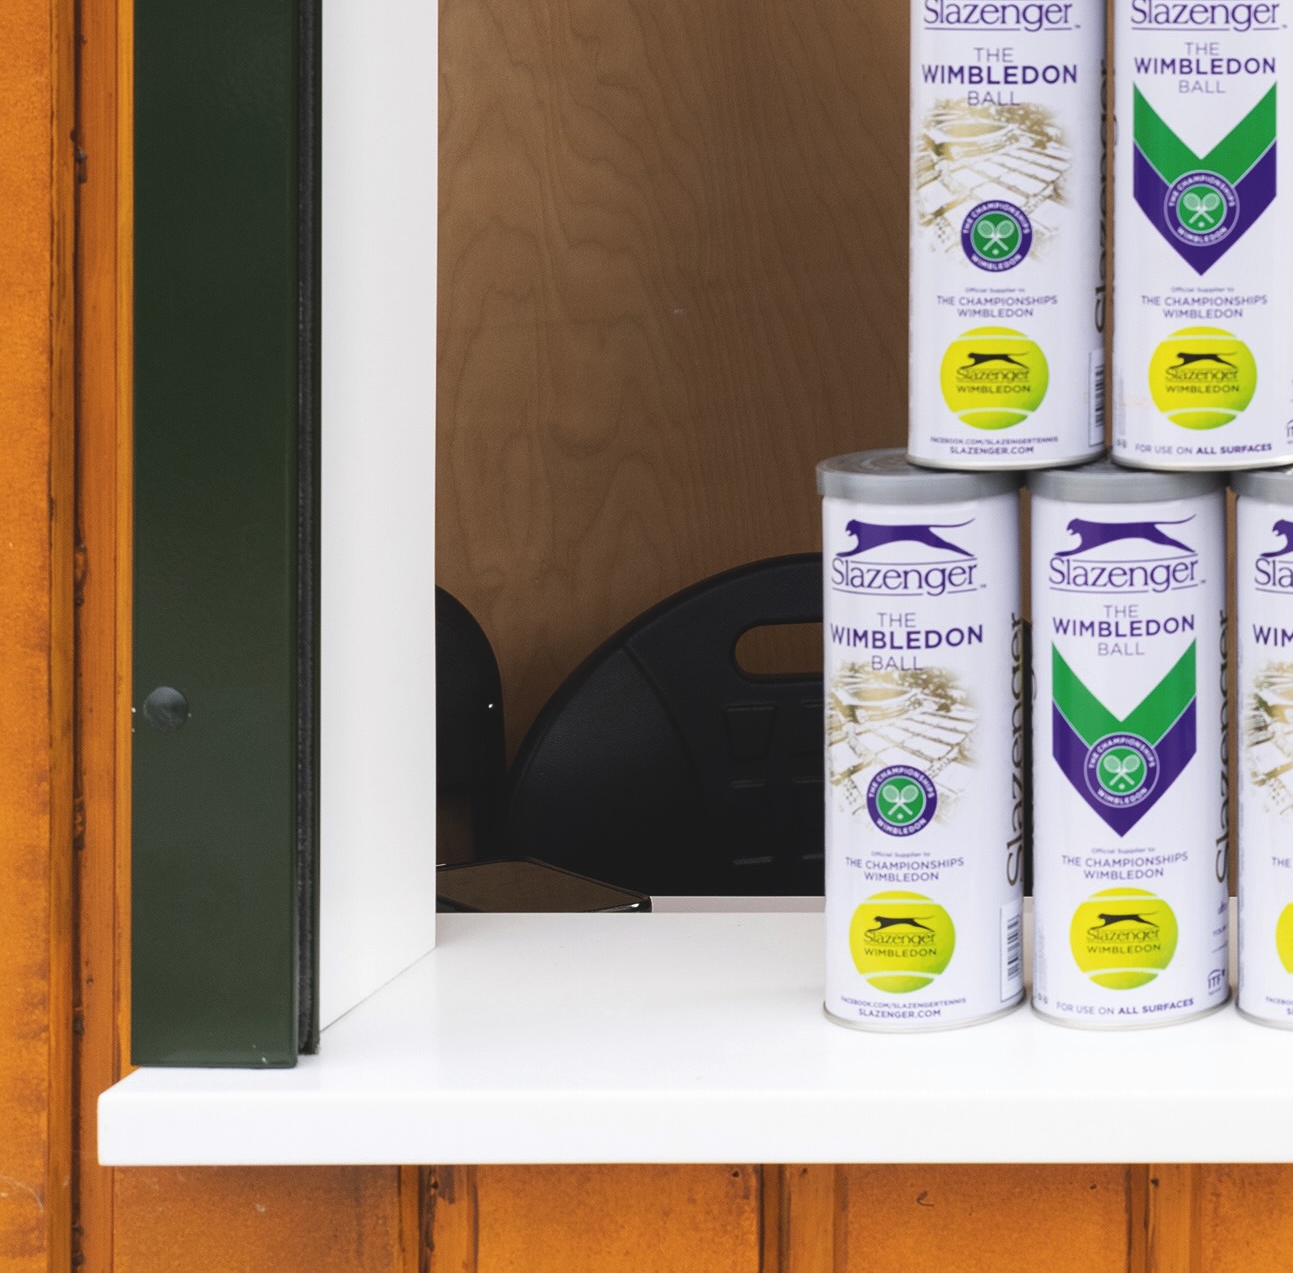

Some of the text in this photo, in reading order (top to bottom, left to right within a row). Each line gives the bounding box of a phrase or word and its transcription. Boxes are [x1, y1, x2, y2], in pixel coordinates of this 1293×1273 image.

[974, 47, 1013, 62] THE
[1185, 42, 1219, 55] THE
[1135, 58, 1275, 73] WIMBLEDON
[922, 64, 1077, 84] WIMBLEDON
[1178, 80, 1226, 93] BALL
[967, 91, 1020, 106] BALL
[937, 295, 1058, 306] THE CHAMPIONSHIPS
[1141, 295, 1267, 306] THE CHAMPIONSHIPS
[957, 308, 1033, 318] WIMBLEDON
[1163, 308, 1243, 319] WIMBLEDON
[950, 446, 1034, 454] SLAZENGER.COM
[1220, 443, 1272, 454] SURFACES
[832, 558, 977, 596] Slazenger
[1050, 557, 1198, 593] Slazenger
[1104, 605, 1138, 618] THE
[877, 613, 916, 628] THE
[1052, 614, 1194, 637] WIMBLEDON
[830, 625, 983, 650] WIMBLEDON
[1098, 642, 1144, 656] BALL
[872, 656, 924, 671] BALL
[846, 857, 964, 870] THE CHAMPIONSHIPS
[1062, 852, 1188, 868] THE CHAMPIONSHIPS
[1272, 856, 1290, 868] THE
[864, 872, 939, 882] WIMBLEDON
[1084, 868, 1163, 880] WIMBLEDON
[864, 948, 936, 956] WIMBLEDON
[858, 1008, 941, 1018] SLAZENGER.COM
[1056, 998, 1194, 1015] FOR USE ON ALL SURFACES
